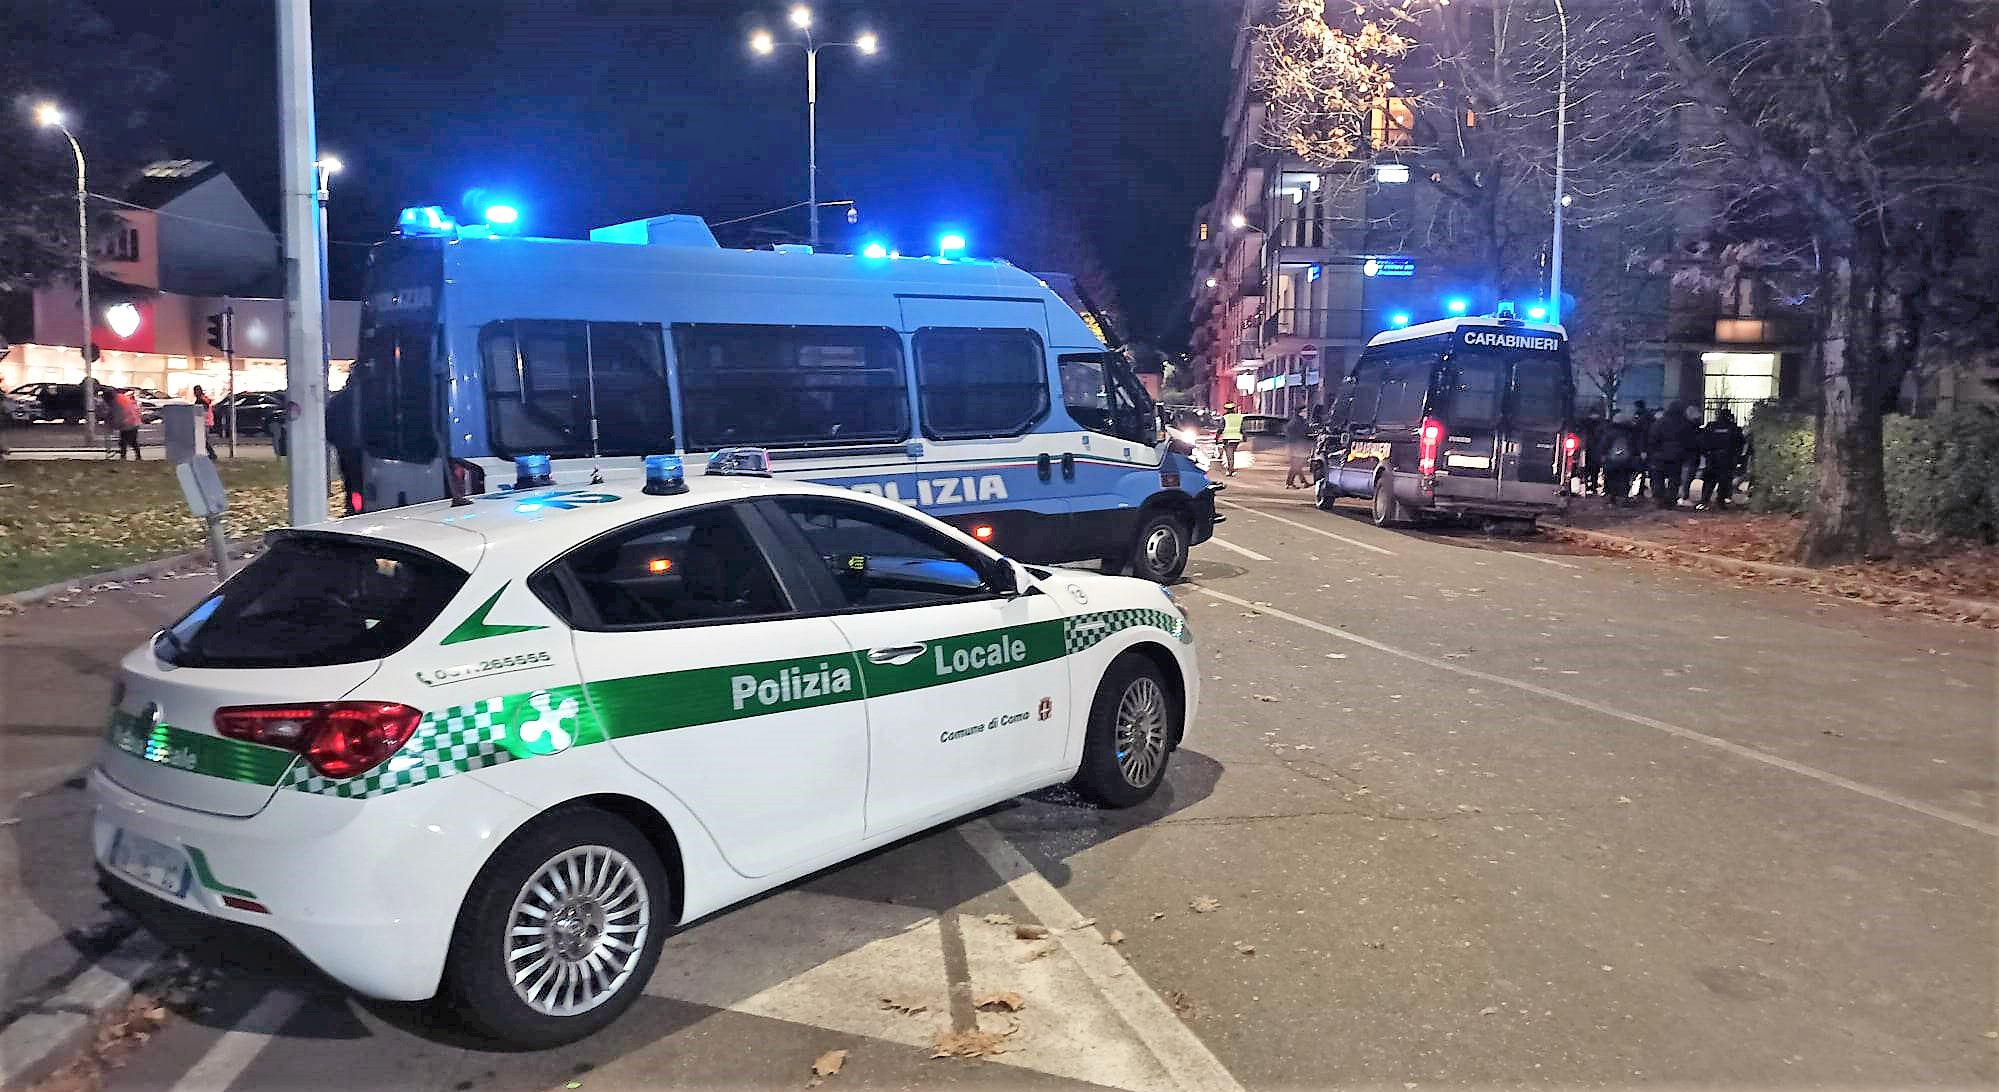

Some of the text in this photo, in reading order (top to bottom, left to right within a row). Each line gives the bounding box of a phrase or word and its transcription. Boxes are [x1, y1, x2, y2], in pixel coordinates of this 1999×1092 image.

[1464, 331, 1559, 351] CARABINIERI
[836, 474, 1009, 506] LIZIA
[731, 634, 1026, 710] Polizia Locale
[940, 711, 1030, 743] Comune di Como
